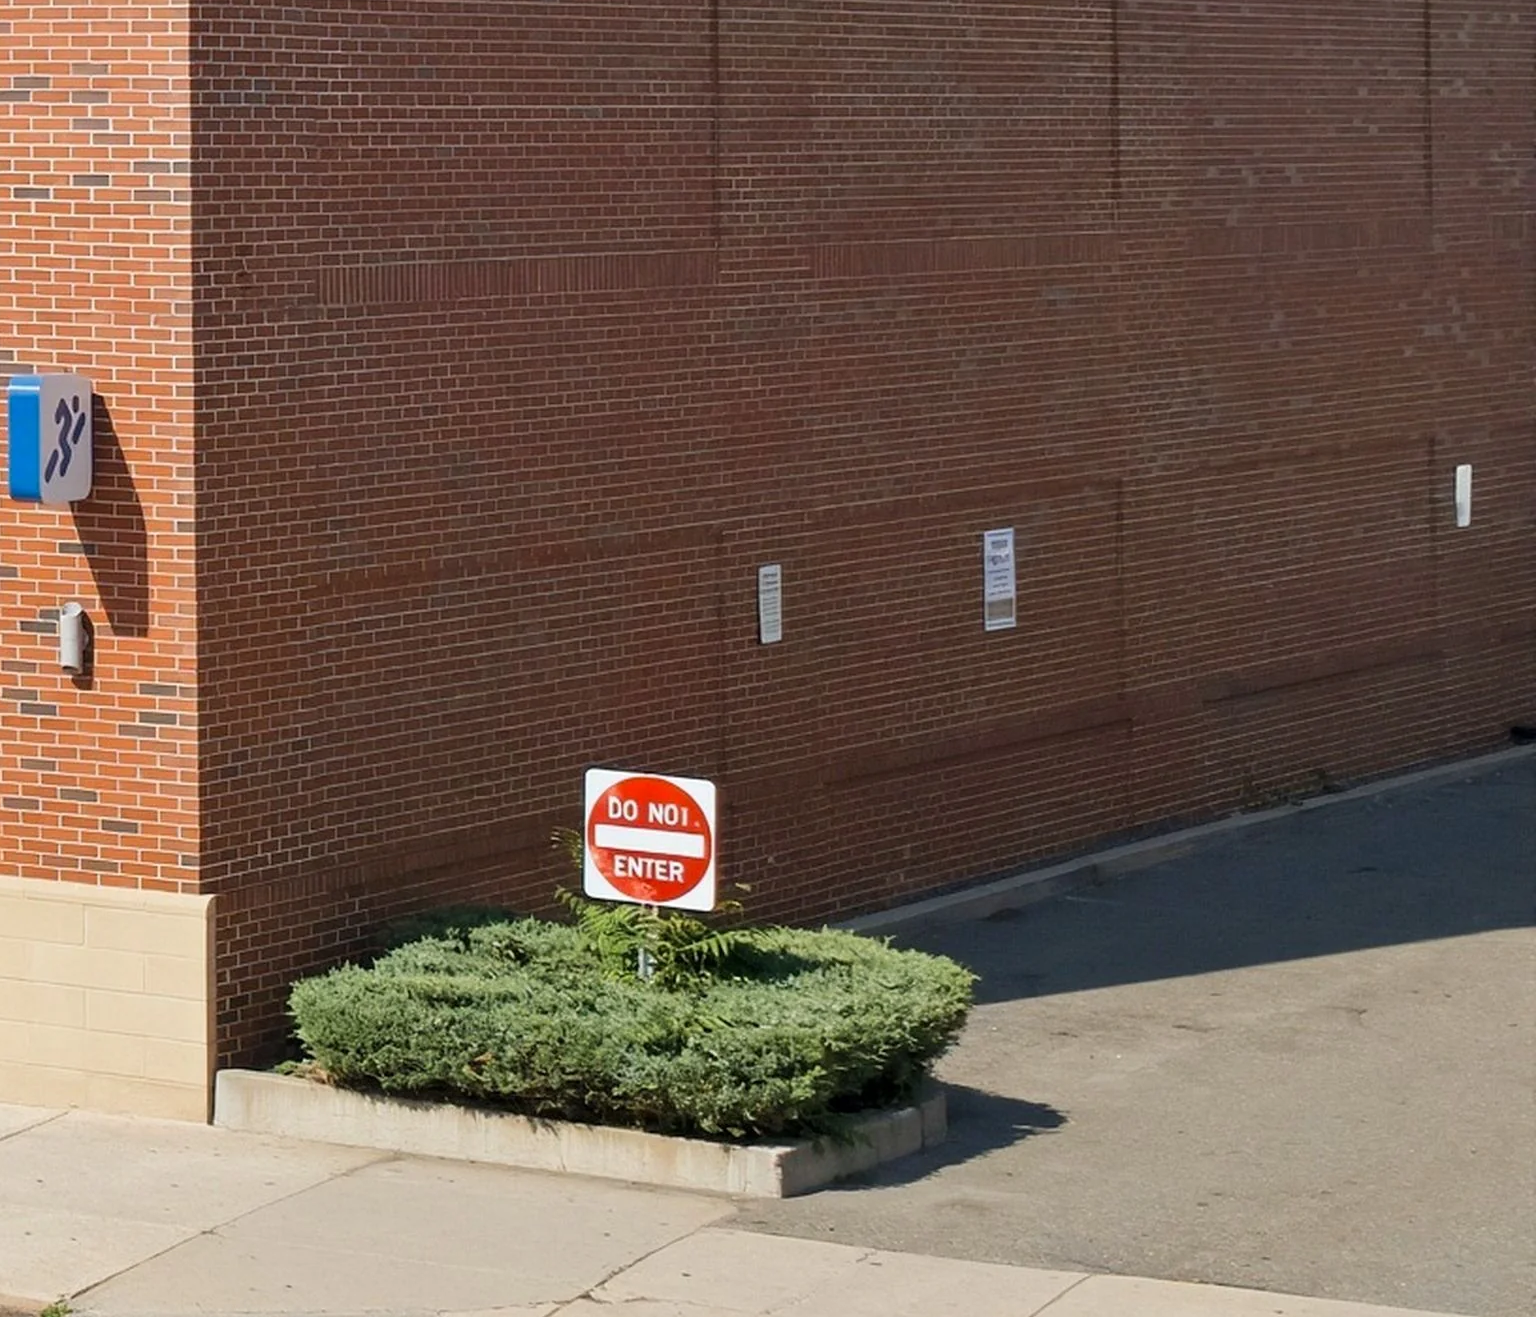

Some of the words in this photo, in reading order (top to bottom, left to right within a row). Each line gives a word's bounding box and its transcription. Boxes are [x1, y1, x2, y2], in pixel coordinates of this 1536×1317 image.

[608, 795, 638, 821] DO
[648, 802, 689, 827] NOT
[613, 854, 684, 884] ENTER
